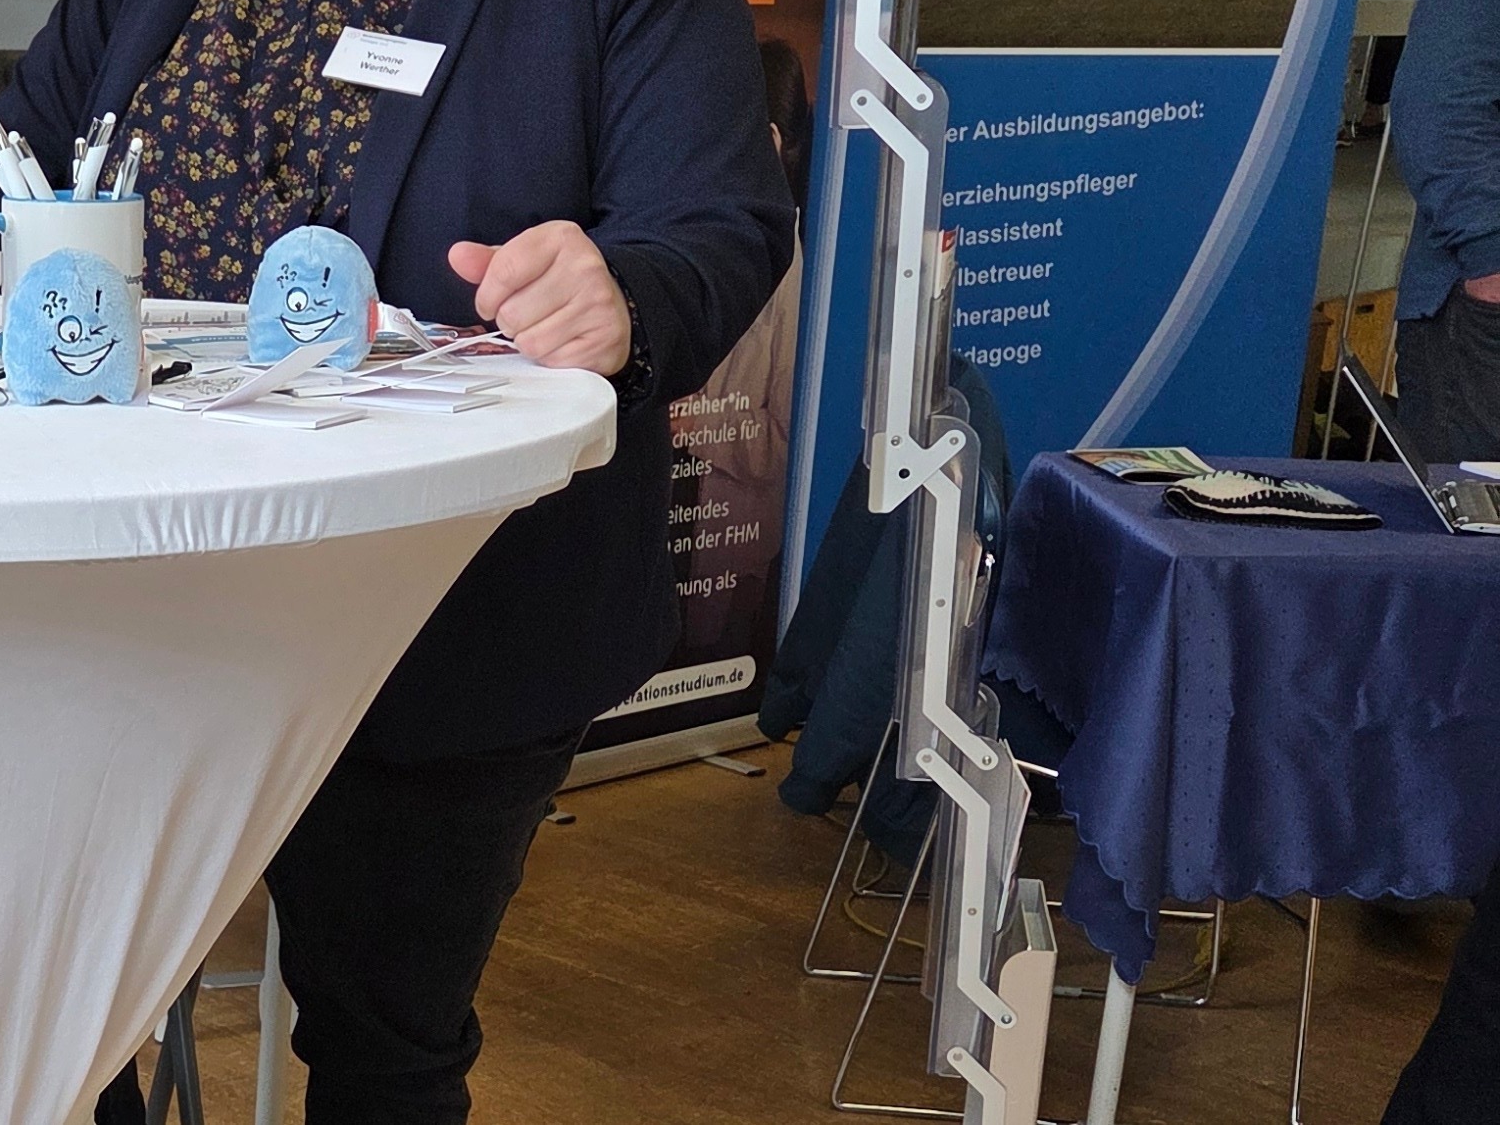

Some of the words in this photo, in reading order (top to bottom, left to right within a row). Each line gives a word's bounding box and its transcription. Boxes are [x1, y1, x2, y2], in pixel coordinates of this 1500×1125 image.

[360, 61, 400, 76] Werther
[367, 51, 404, 65] Yvonne
[972, 99, 1205, 141] Ausbildungsangebot:
[942, 172, 1138, 207] erziehungspfleger
[952, 298, 1051, 327] herapeut
[672, 422, 737, 449] chschule
[740, 419, 762, 441] für
[671, 456, 713, 480] ziales
[695, 529, 722, 550] der
[724, 521, 760, 547] FHM
[715, 569, 737, 591] als
